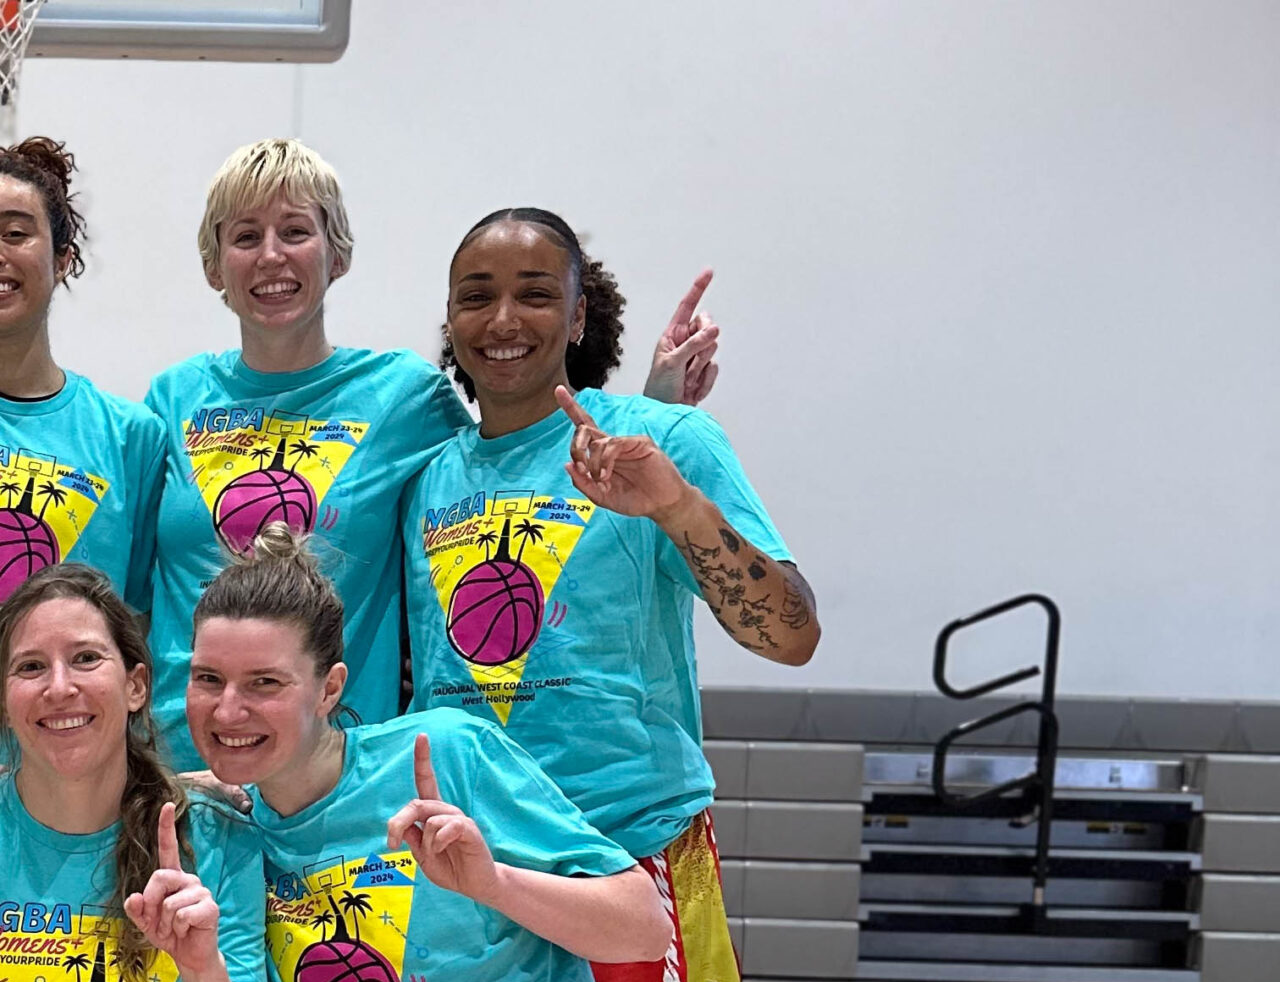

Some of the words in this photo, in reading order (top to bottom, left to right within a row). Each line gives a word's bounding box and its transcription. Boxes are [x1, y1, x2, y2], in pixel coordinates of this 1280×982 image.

[186, 407, 264, 435] NGBA
[309, 424, 339, 433] MARCH
[325, 433, 345, 441] 2024
[57, 469, 86, 483] MARCH
[71, 481, 90, 494] 2024
[423, 491, 486, 534] NGBA
[533, 502, 565, 511] MARCH
[565, 503, 591, 512] 23-24
[548, 511, 572, 520] 2024
[477, 683, 502, 692] WEST
[504, 682, 534, 691] COAST
[535, 677, 572, 689] CLASSIC
[461, 696, 484, 706] West
[485, 692, 536, 704] Hollywood
[349, 862, 383, 876] MARCH
[384, 858, 412, 870] 23-24
[370, 874, 394, 884] 2024
